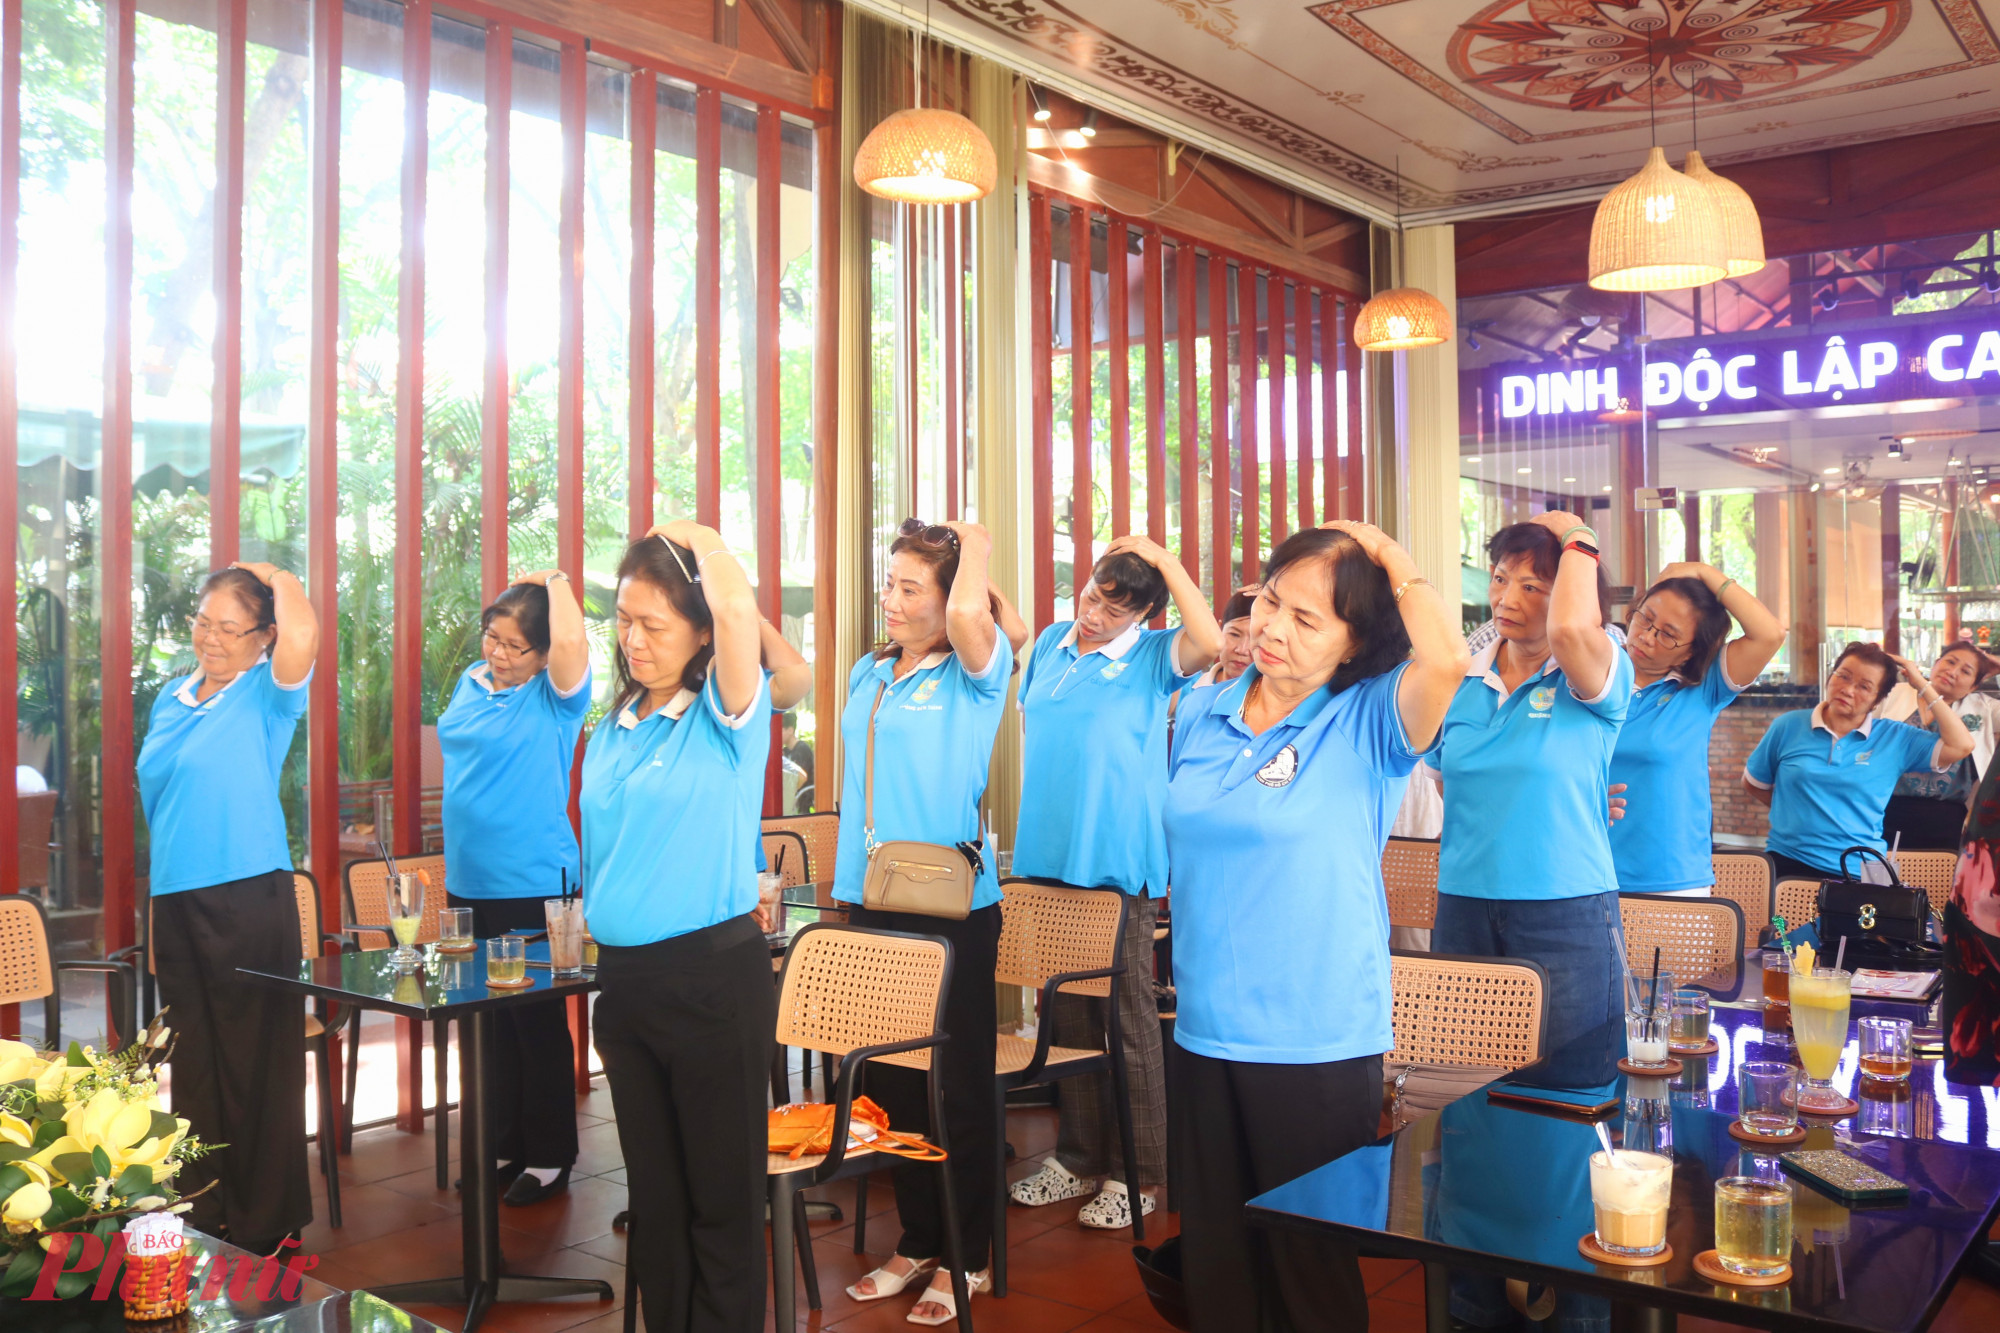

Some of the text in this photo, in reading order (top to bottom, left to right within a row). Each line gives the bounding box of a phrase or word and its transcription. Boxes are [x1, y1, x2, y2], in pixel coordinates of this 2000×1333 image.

[1501, 330, 2000, 418] DINH ĐỘC LẬP CA
